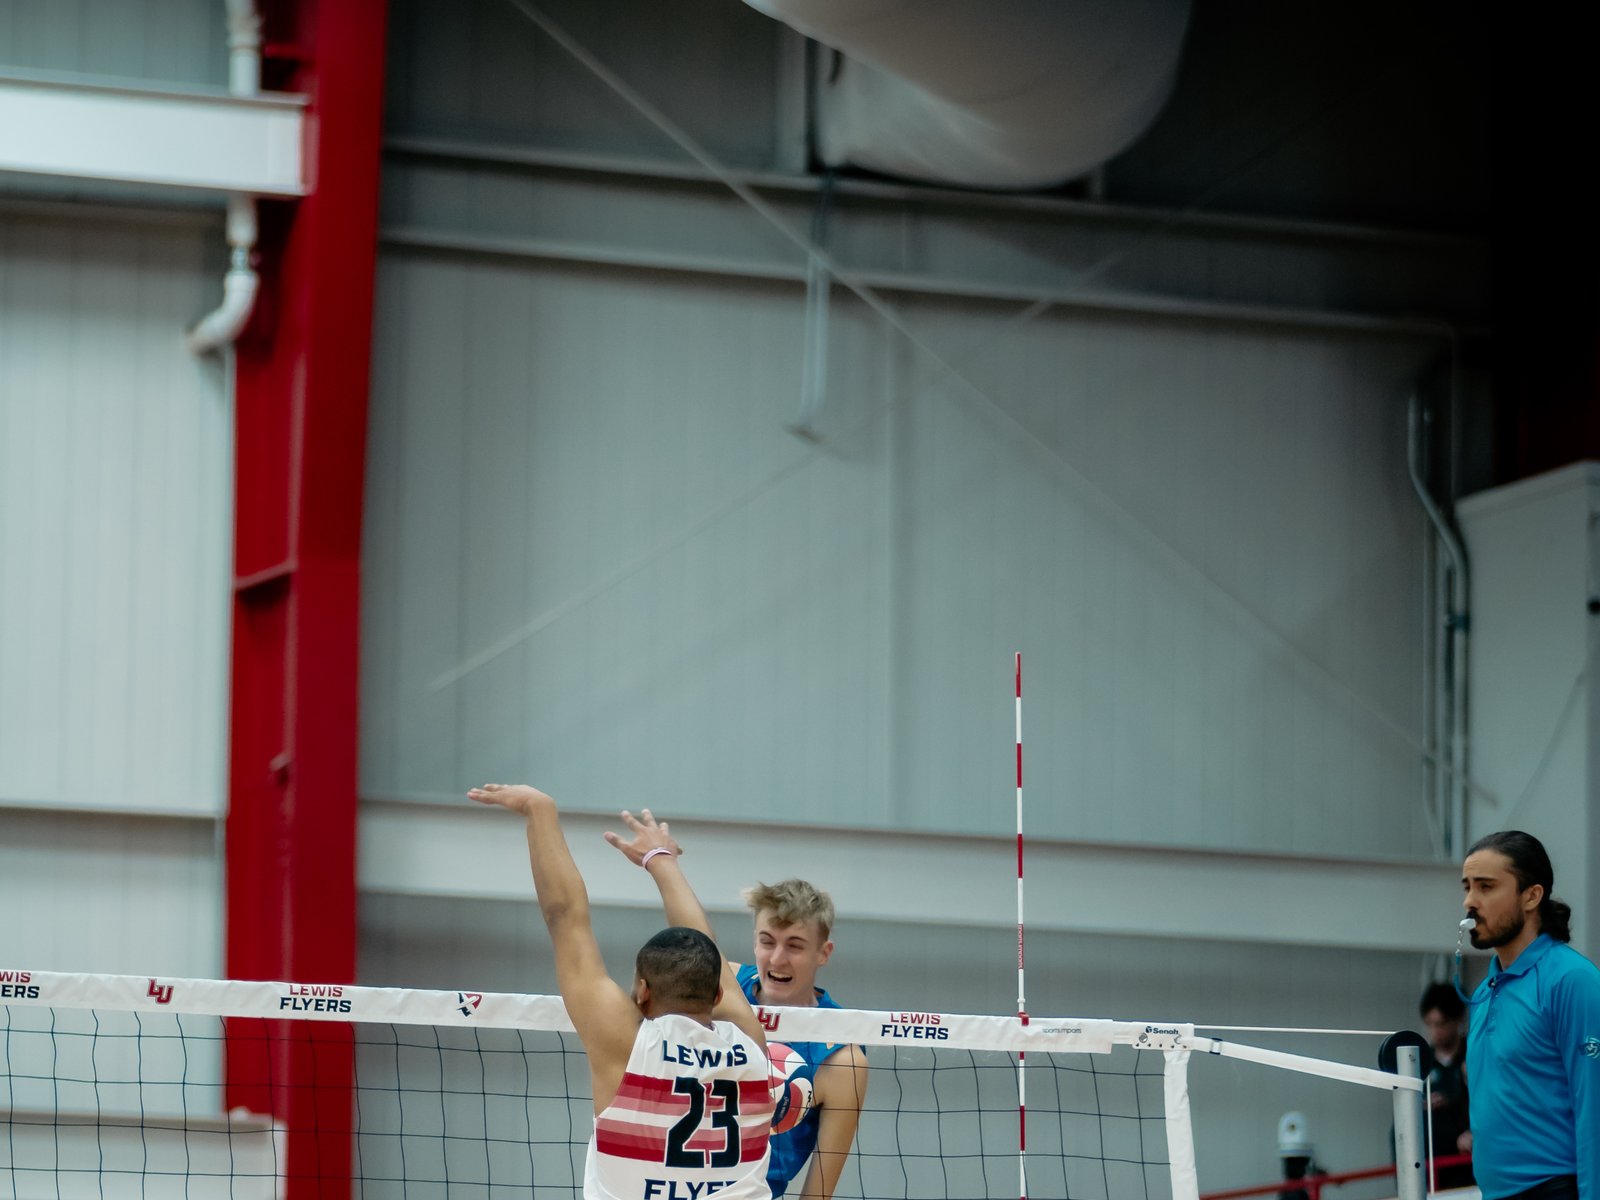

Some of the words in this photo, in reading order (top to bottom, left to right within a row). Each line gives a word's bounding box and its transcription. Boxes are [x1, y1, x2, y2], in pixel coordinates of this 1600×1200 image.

[0, 971, 31, 983] WIS
[1, 985, 40, 999] ERS
[289, 985, 343, 997] LEWIS
[280, 997, 352, 1013] FLYERS
[890, 1013, 941, 1025] LEWIS
[881, 1024, 949, 1040] FLYERS
[1153, 1027, 1179, 1035] Senoh
[663, 1040, 748, 1069] LEWIS
[665, 1076, 741, 1169] 23
